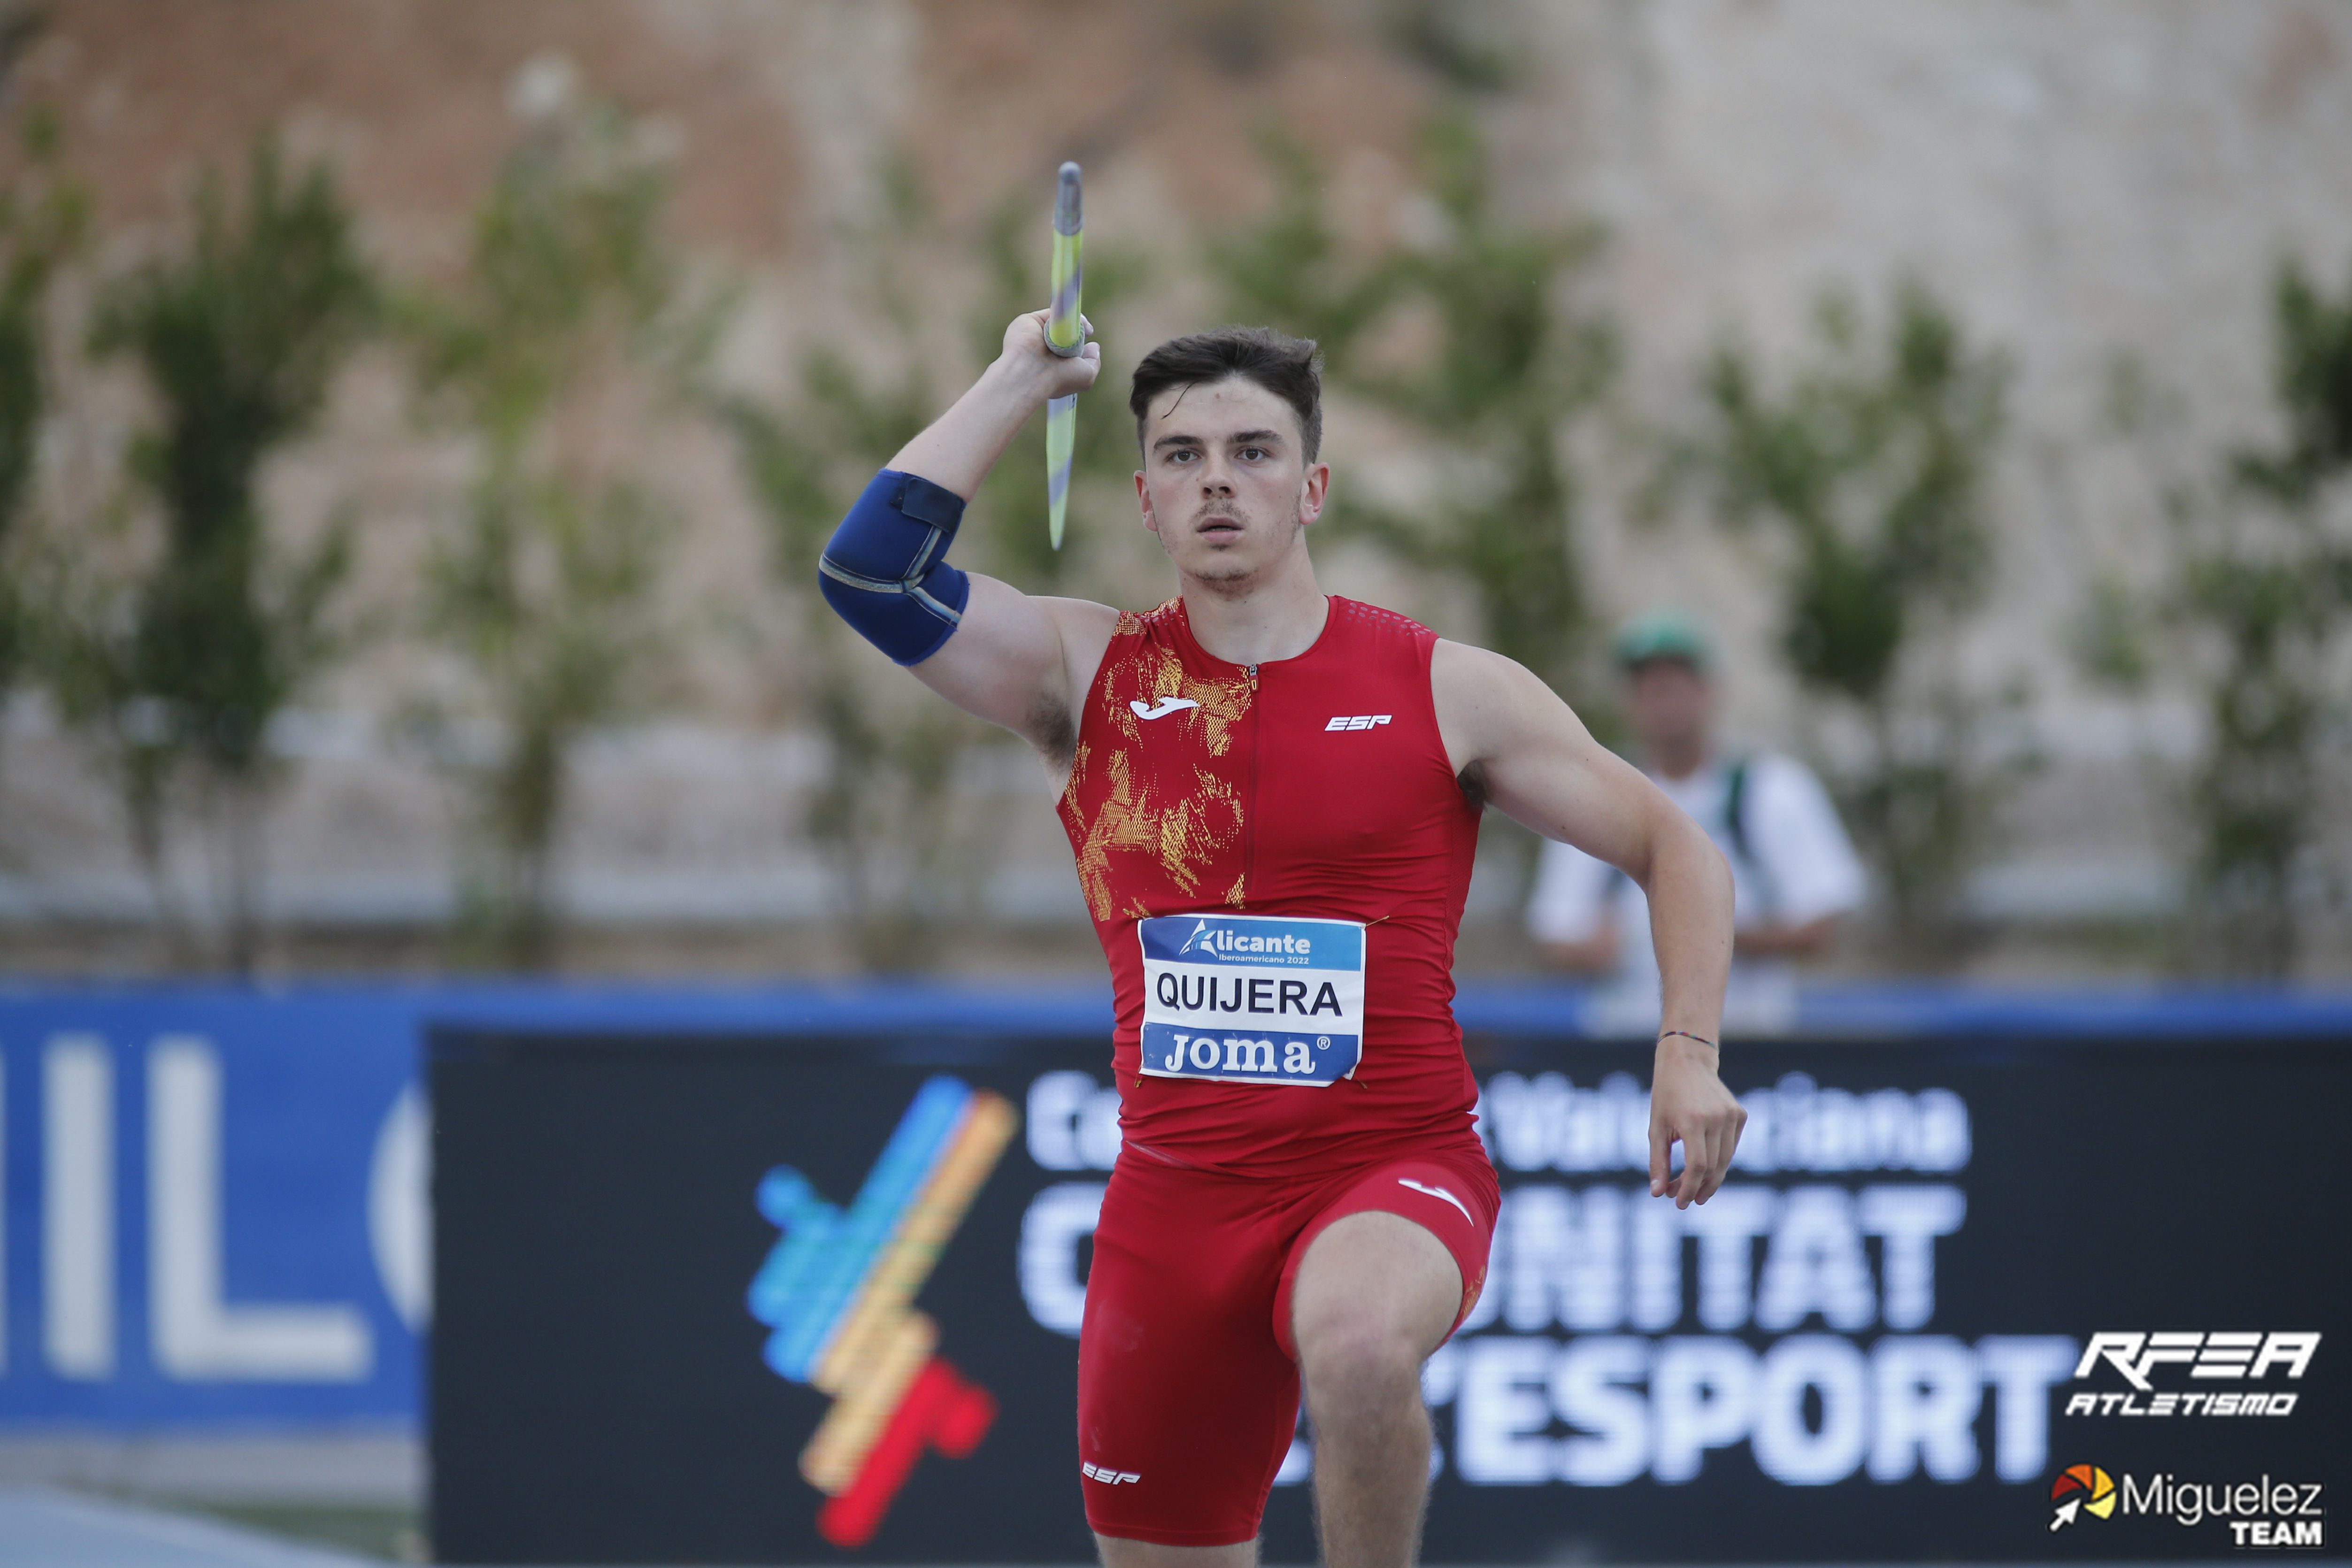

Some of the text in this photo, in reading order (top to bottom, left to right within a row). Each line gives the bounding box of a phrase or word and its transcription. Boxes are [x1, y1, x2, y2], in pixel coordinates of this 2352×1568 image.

[1324, 714, 1393, 732] ESP
[1179, 919, 1310, 957] Alicante
[1219, 954, 1309, 965] Iberoamericano 2022
[1156, 972, 1343, 1017] QUIJERA
[1082, 1461, 1141, 1485] ESP
